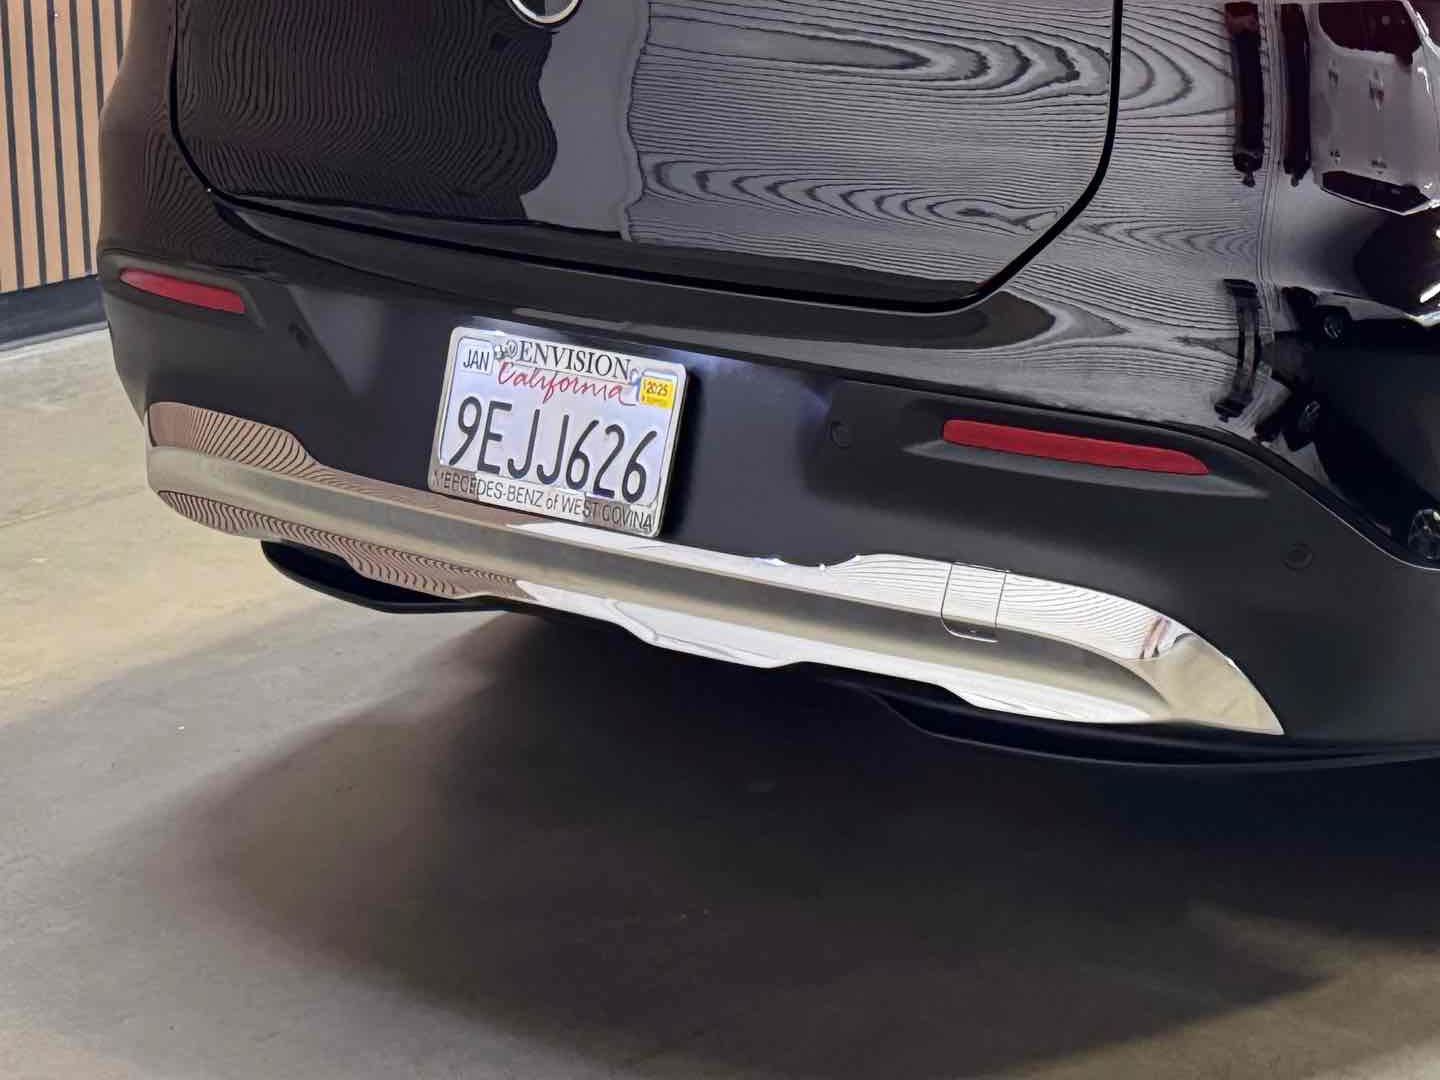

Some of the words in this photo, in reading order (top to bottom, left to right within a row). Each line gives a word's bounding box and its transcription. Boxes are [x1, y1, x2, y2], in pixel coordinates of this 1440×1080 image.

[463, 349, 490, 372] JAN
[518, 340, 631, 381] ENVISION
[498, 361, 637, 407] California
[448, 396, 658, 504] 9EJJ626
[433, 471, 544, 507] MERCEDES-BENZ
[545, 494, 559, 510] of
[561, 495, 598, 519] WEST
